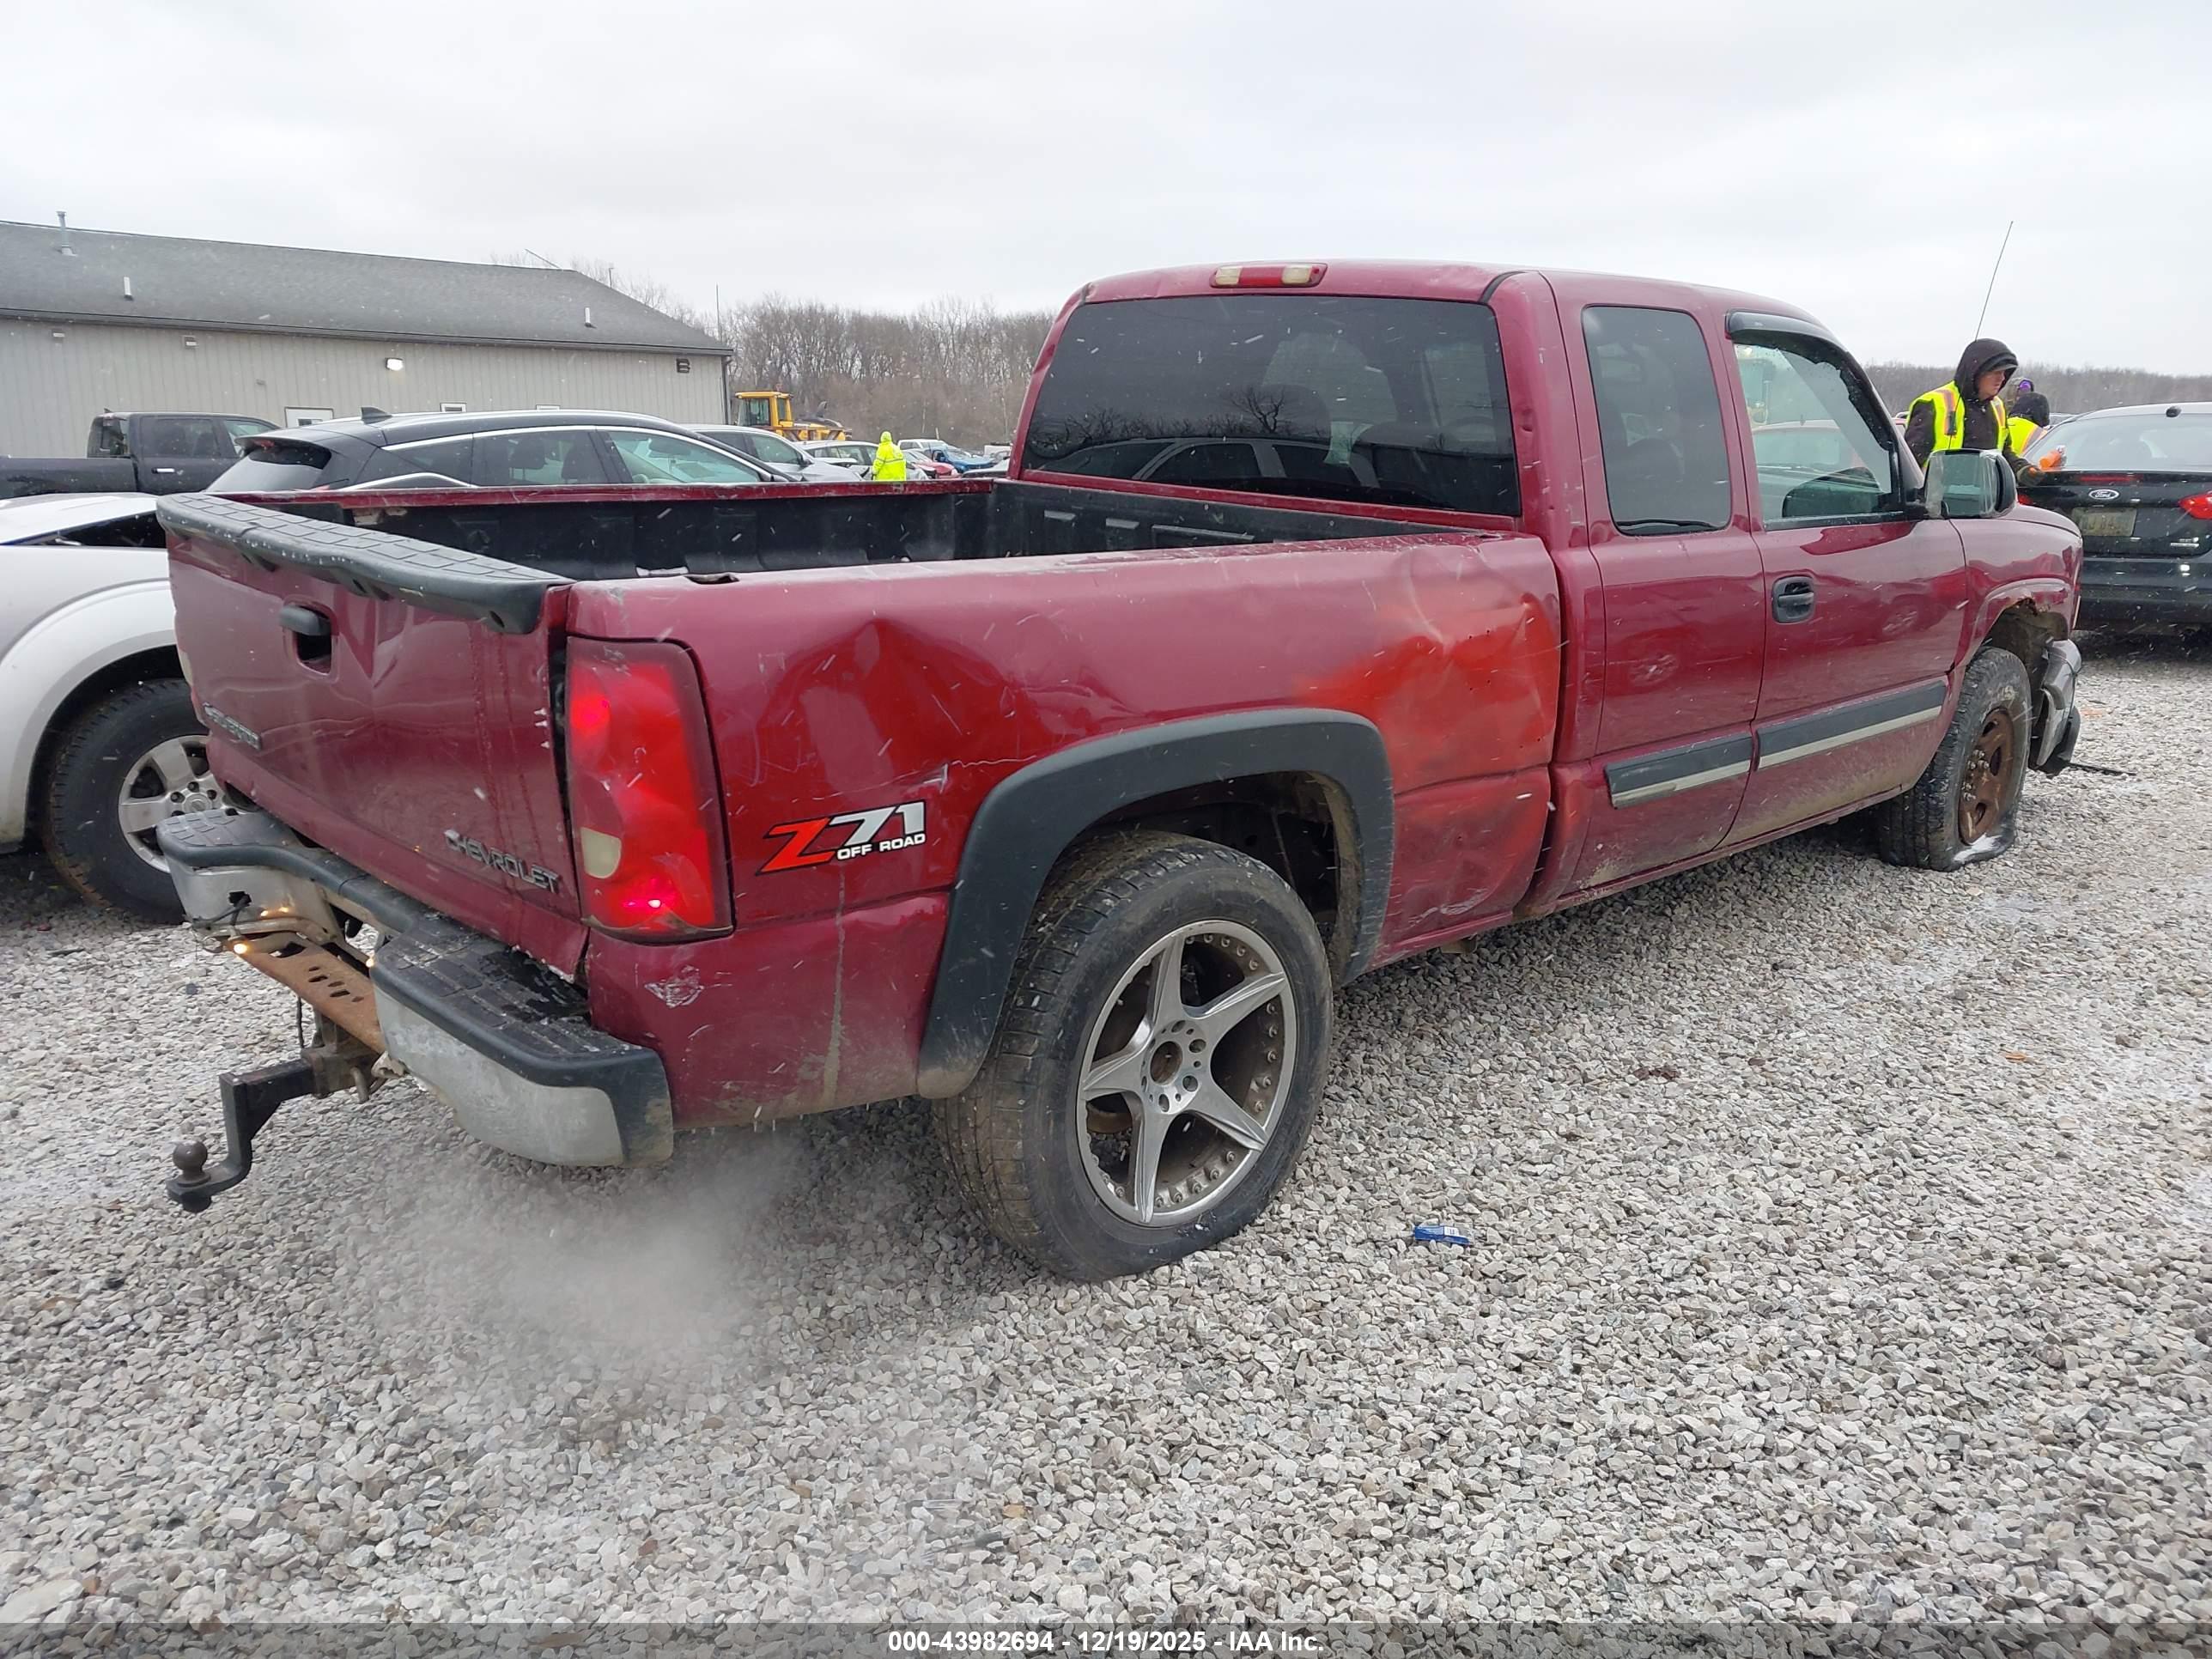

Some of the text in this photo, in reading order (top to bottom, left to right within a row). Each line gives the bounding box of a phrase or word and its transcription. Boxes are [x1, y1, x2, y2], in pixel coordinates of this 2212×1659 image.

[444, 830, 559, 893] CHEVROLET
[758, 802, 925, 874] Z71
[836, 833, 926, 860] OFF ROAD
